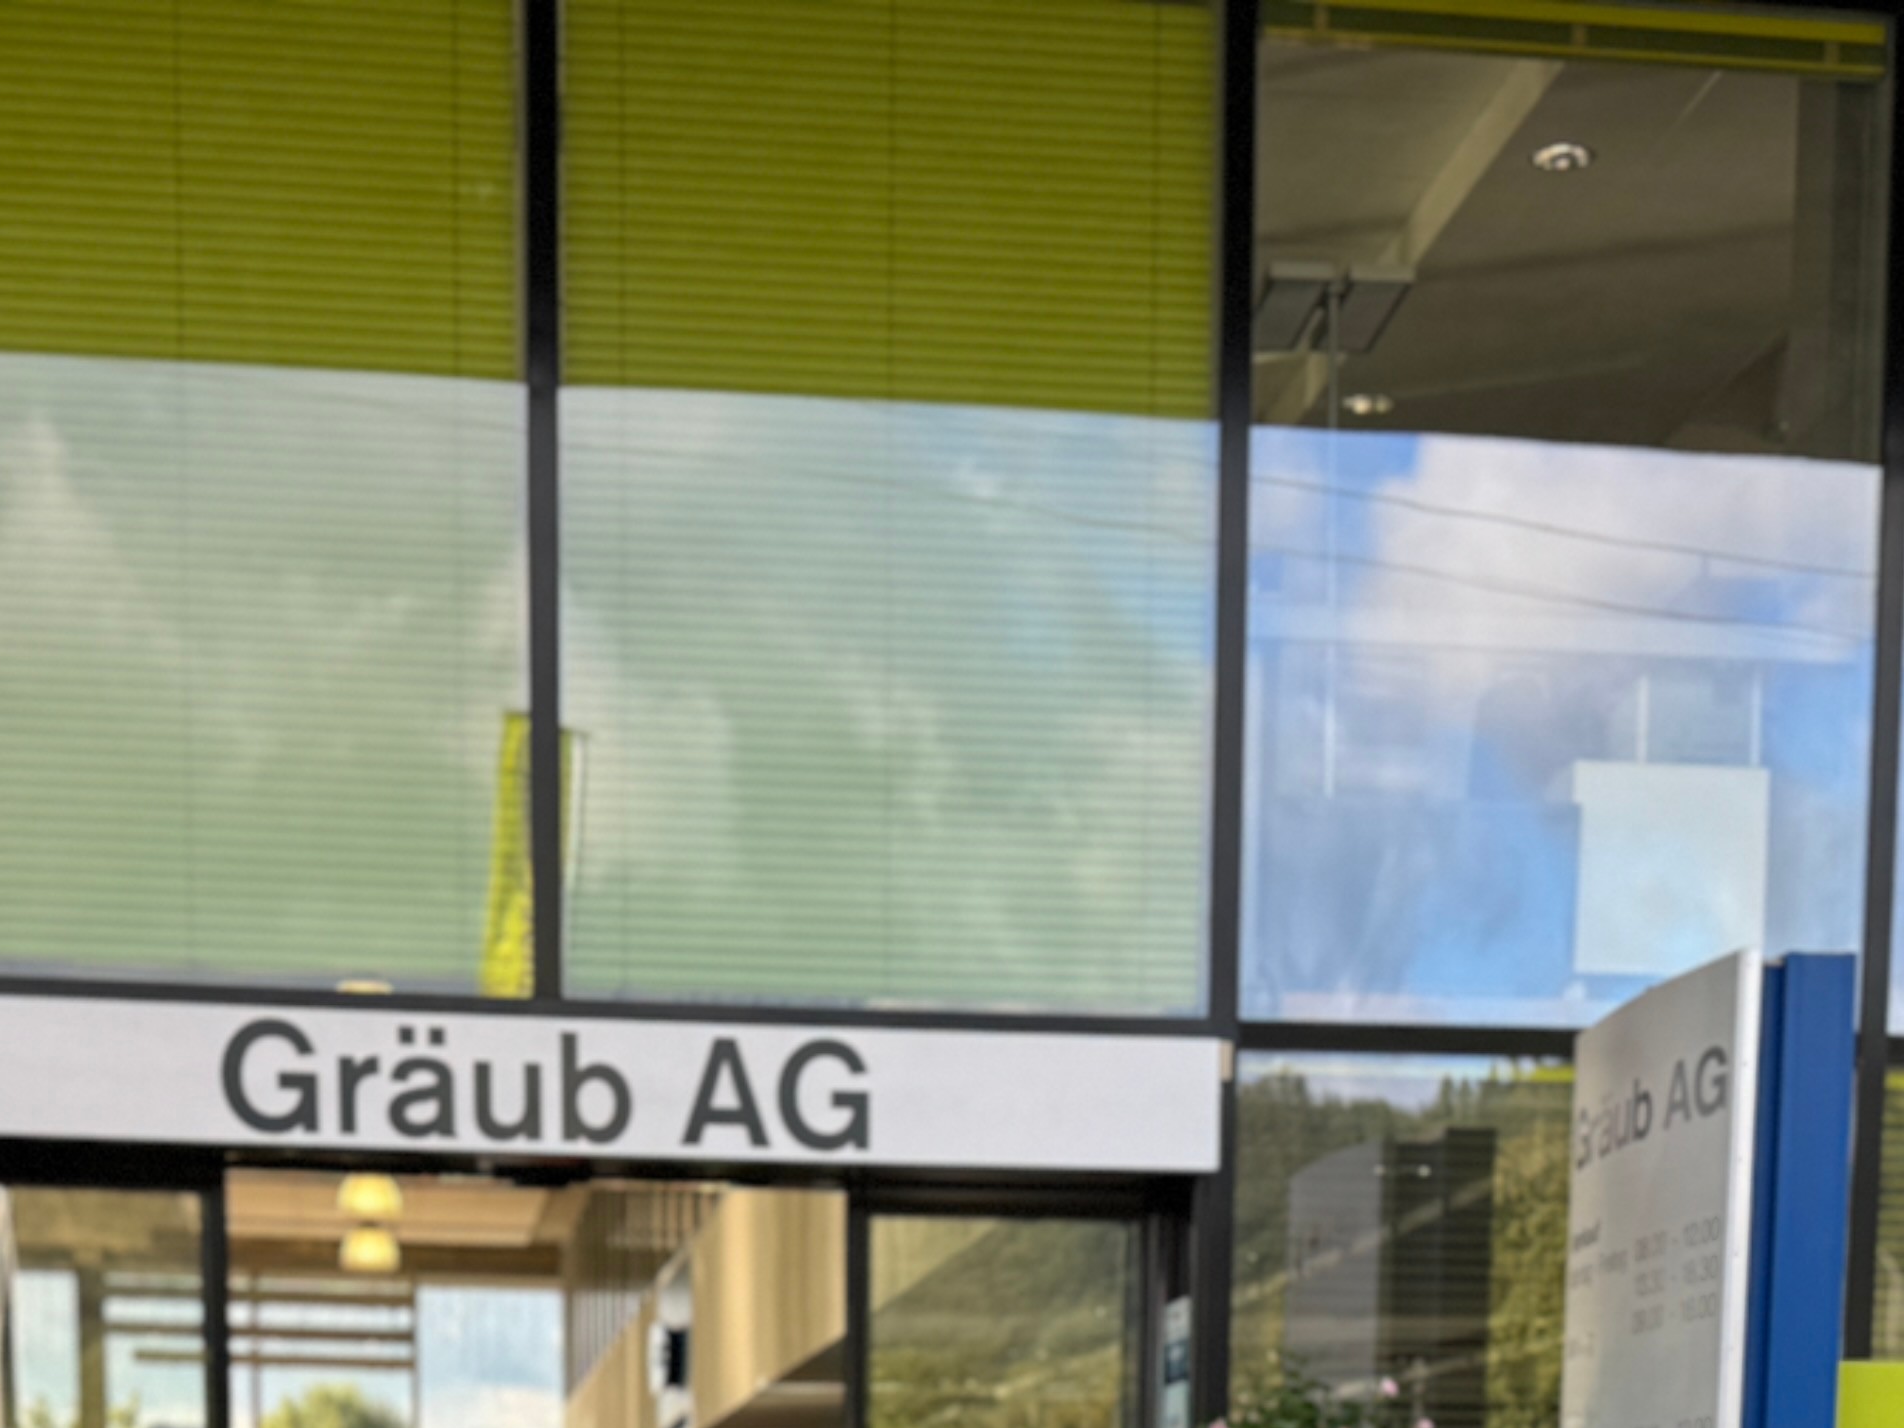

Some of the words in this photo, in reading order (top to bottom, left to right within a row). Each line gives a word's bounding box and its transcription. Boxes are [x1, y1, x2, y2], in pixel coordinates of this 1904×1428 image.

[221, 1019, 633, 1145] Gräub
[682, 1038, 872, 1152] AG
[1664, 1045, 1729, 1131] AG
